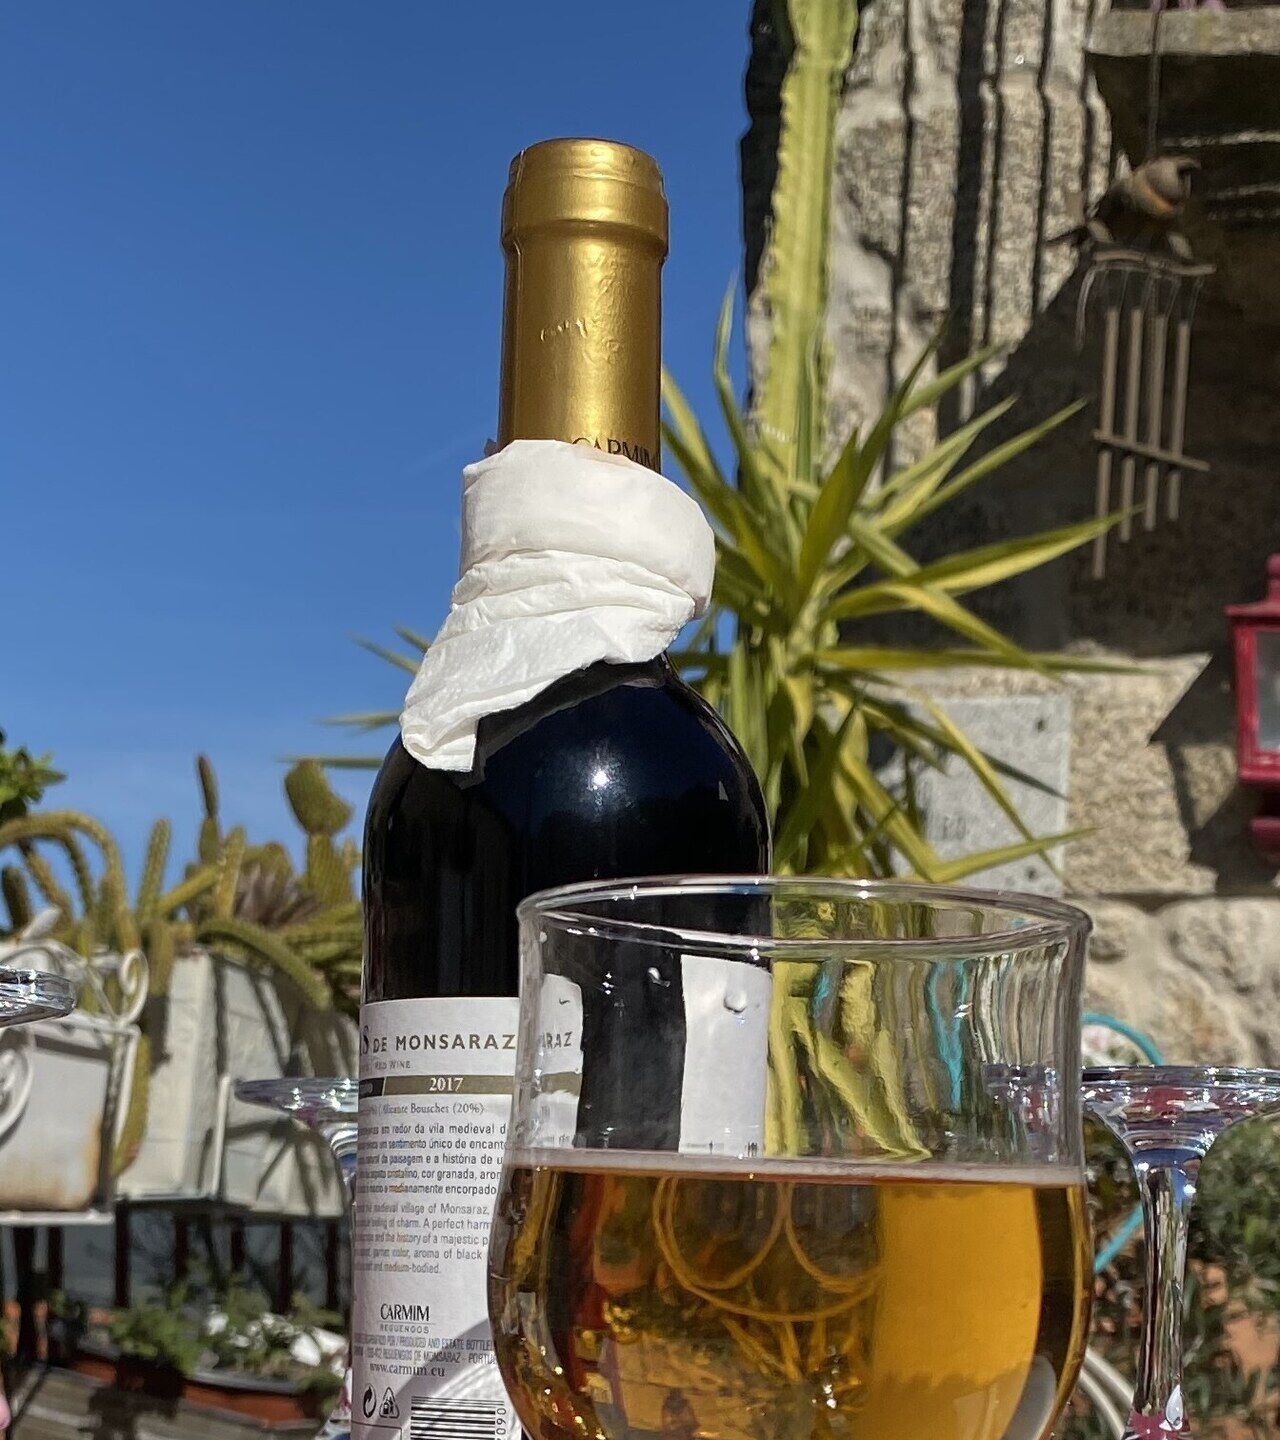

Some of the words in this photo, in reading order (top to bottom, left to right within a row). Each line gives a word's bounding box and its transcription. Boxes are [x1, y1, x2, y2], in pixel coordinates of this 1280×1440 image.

[373, 1036, 387, 1052] DE
[395, 1033, 516, 1050] MONSARAZ
[429, 1076, 464, 1092] 2017
[452, 1103, 485, 1115] (20%)
[414, 1123, 425, 1133] da
[428, 1123, 445, 1133] vila
[449, 1123, 495, 1134] medieval
[455, 1139, 466, 1149] de
[442, 1153, 477, 1165] história
[480, 1154, 493, 1165] de
[423, 1218, 430, 1227] A
[432, 1219, 464, 1230] perfect
[441, 1234, 479, 1246] majestic
[456, 1250, 483, 1260] black
[380, 1303, 430, 1322] CARMIM
